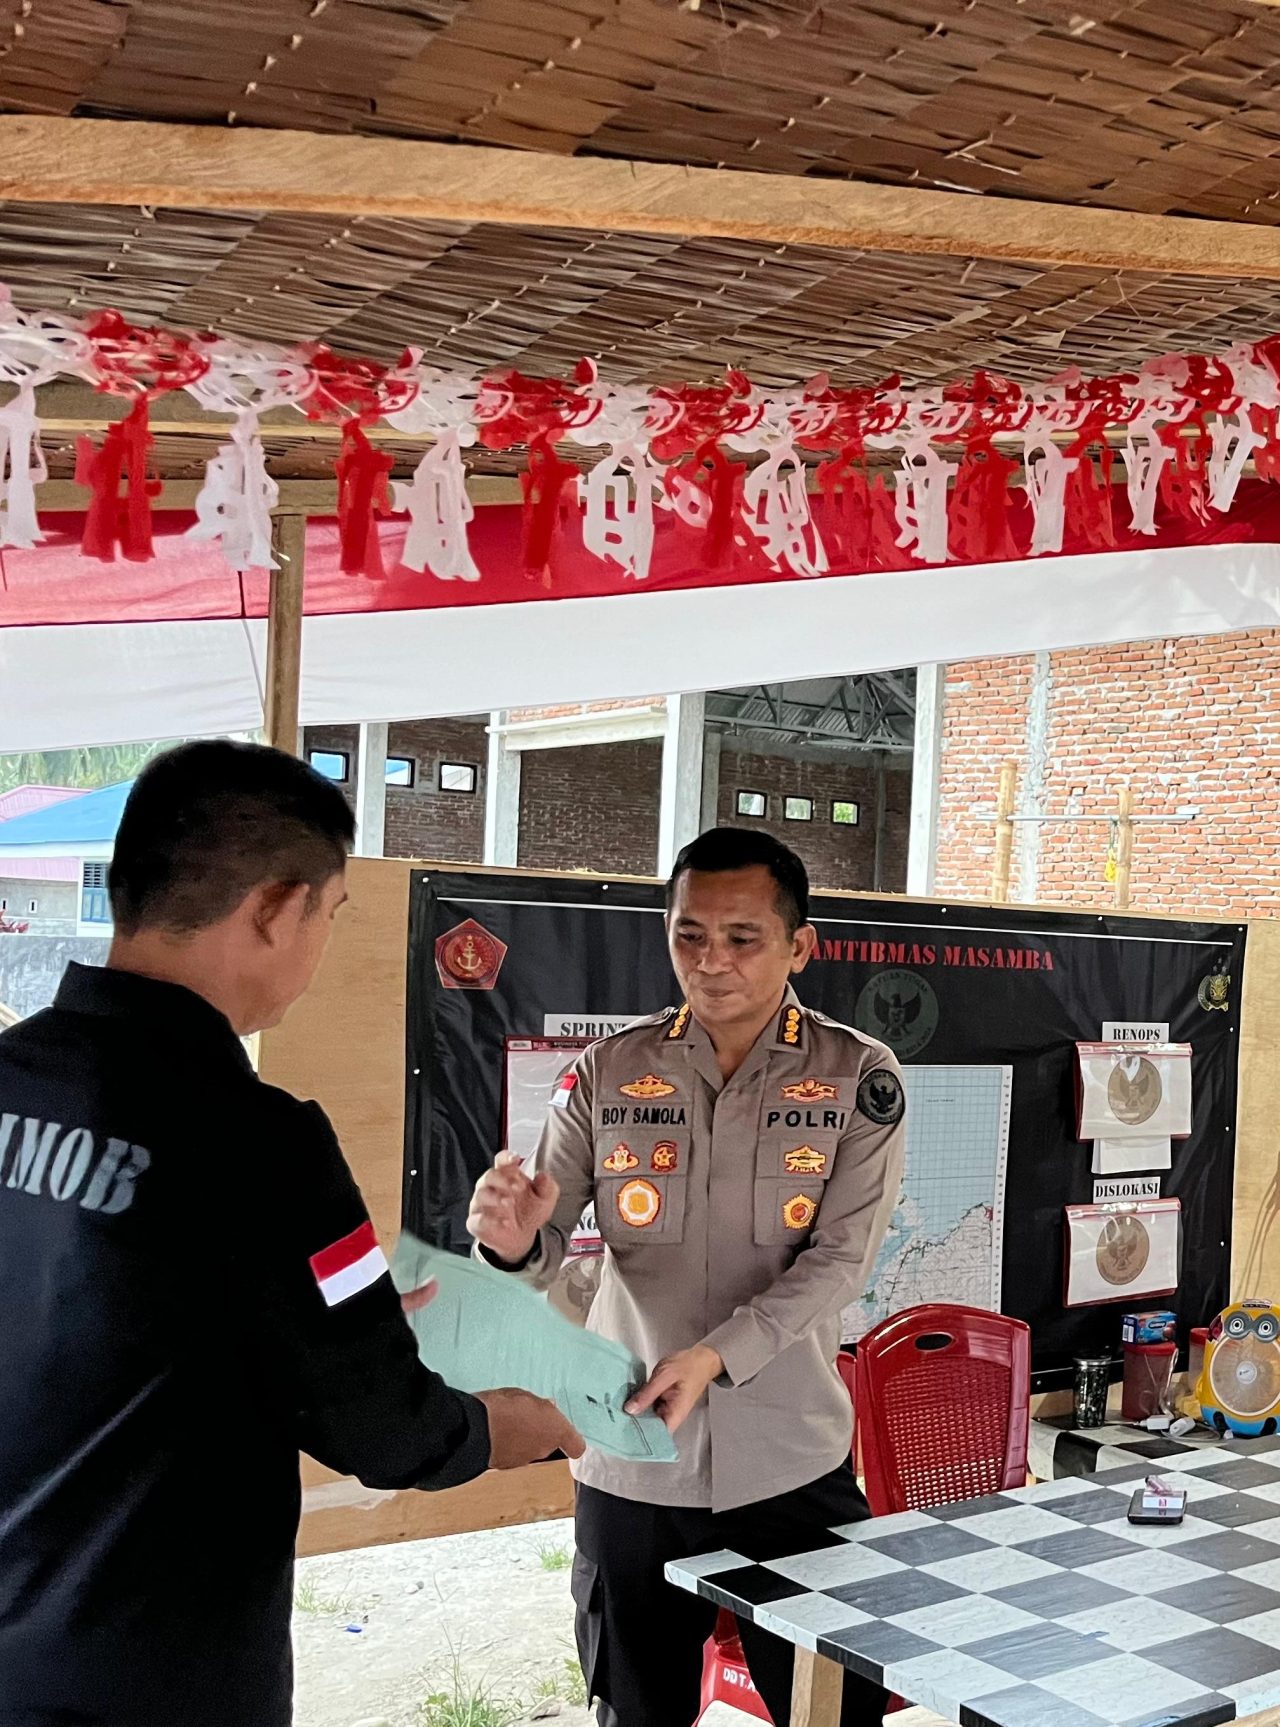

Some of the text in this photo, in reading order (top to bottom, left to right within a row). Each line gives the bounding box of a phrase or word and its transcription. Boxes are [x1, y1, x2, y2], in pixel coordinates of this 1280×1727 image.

[942, 946, 1054, 970] MASAMBA
[1113, 1028, 1161, 1041] RENOPS
[602, 1106, 686, 1125] BOY SAMOLA
[767, 1110, 845, 1130] POLRI
[1095, 1182, 1159, 1198] DISLOKASI
